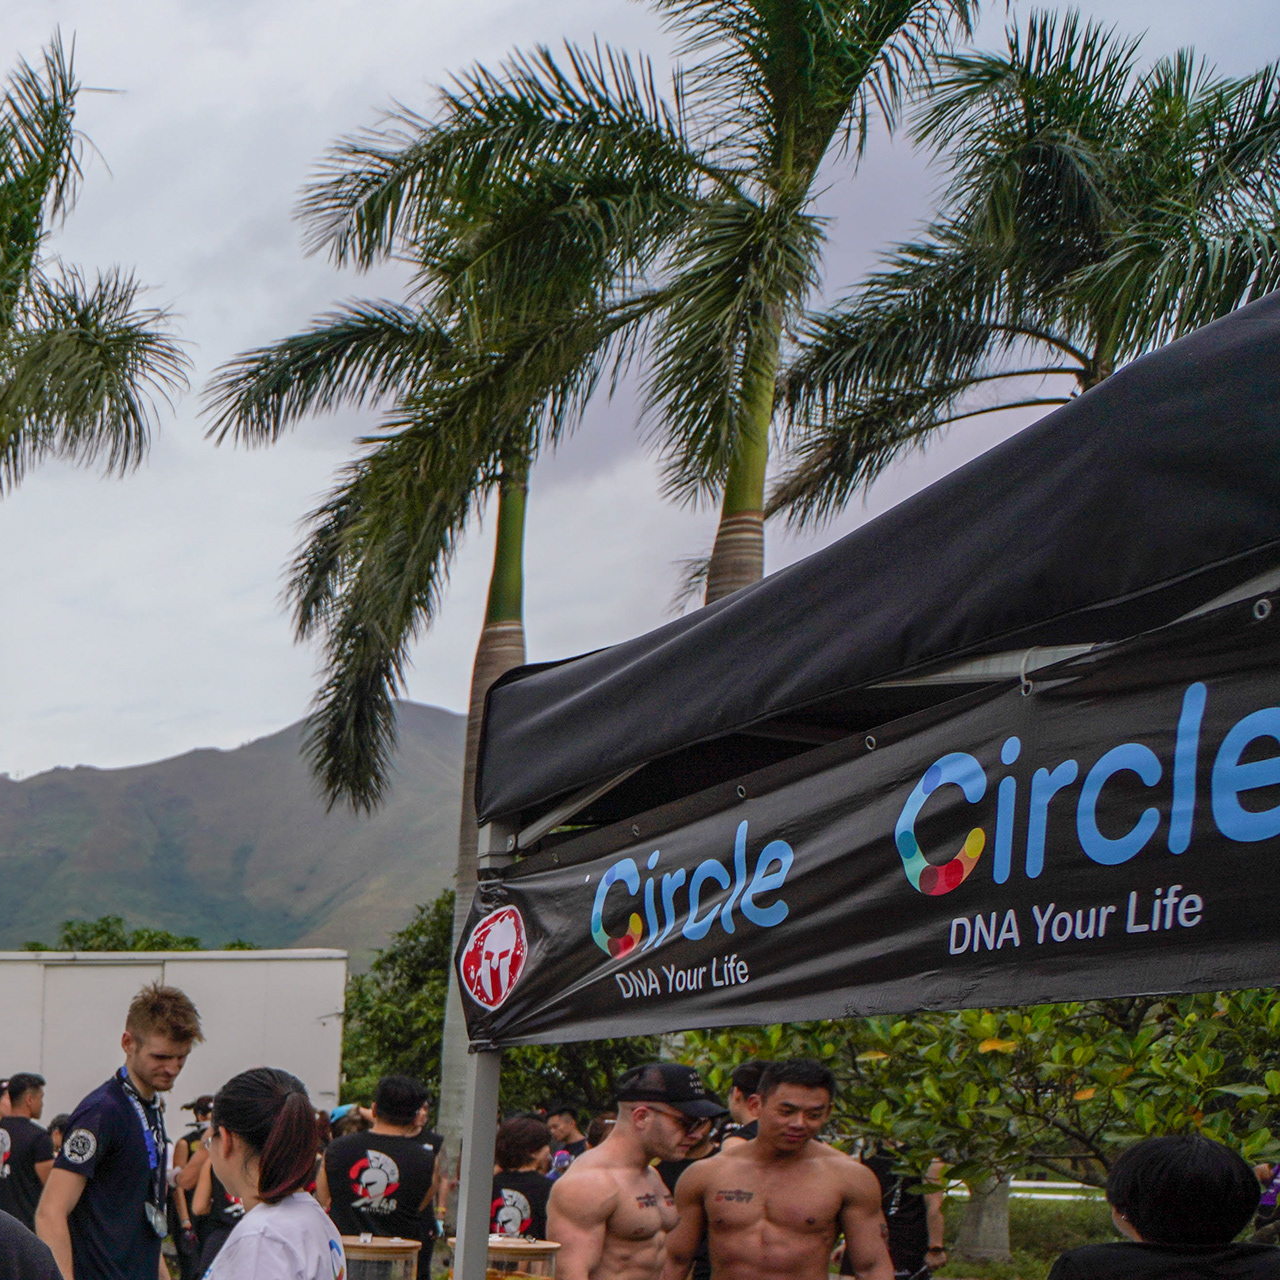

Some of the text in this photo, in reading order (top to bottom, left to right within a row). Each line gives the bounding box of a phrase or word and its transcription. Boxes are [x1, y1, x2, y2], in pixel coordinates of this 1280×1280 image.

[895, 682, 1280, 896] Circle
[591, 819, 795, 961] Circle
[948, 884, 1204, 956] DNA Your Life
[615, 953, 750, 999] DNA Your Life
